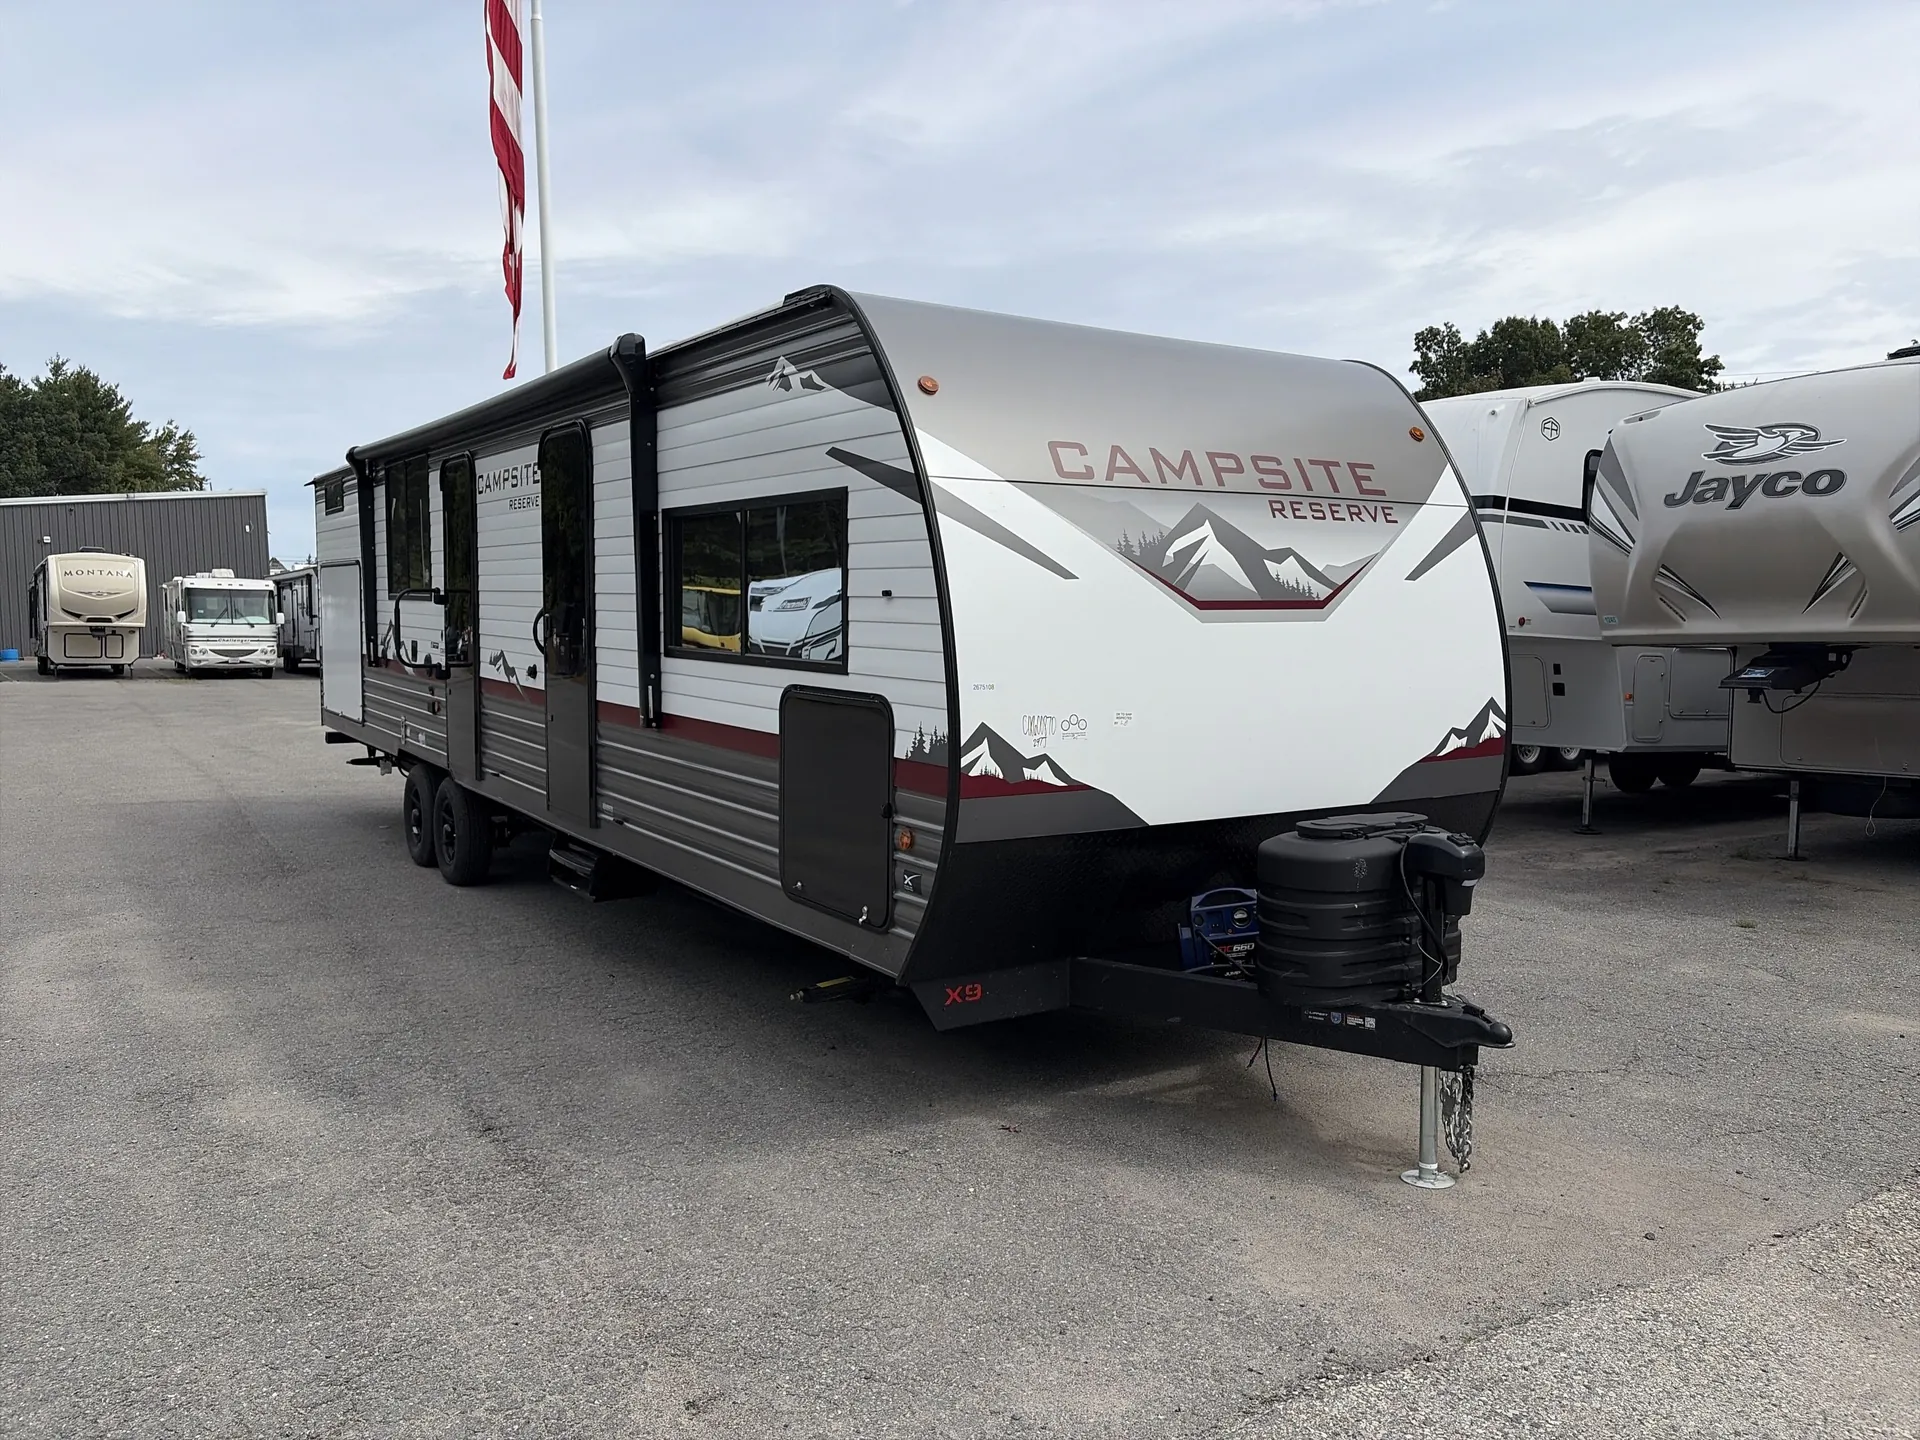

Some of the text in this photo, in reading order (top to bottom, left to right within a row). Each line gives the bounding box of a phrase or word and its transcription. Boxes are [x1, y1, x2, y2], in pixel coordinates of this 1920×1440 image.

[477, 462, 540, 495] CAMPSITE
[1047, 440, 1387, 497] CAMPSITE
[1663, 469, 1848, 510] Jayco
[509, 495, 540, 511] RESERVE
[1268, 499, 1399, 524] RESERVE
[63, 569, 133, 579] MONTANA
[944, 983, 983, 1006] X9
